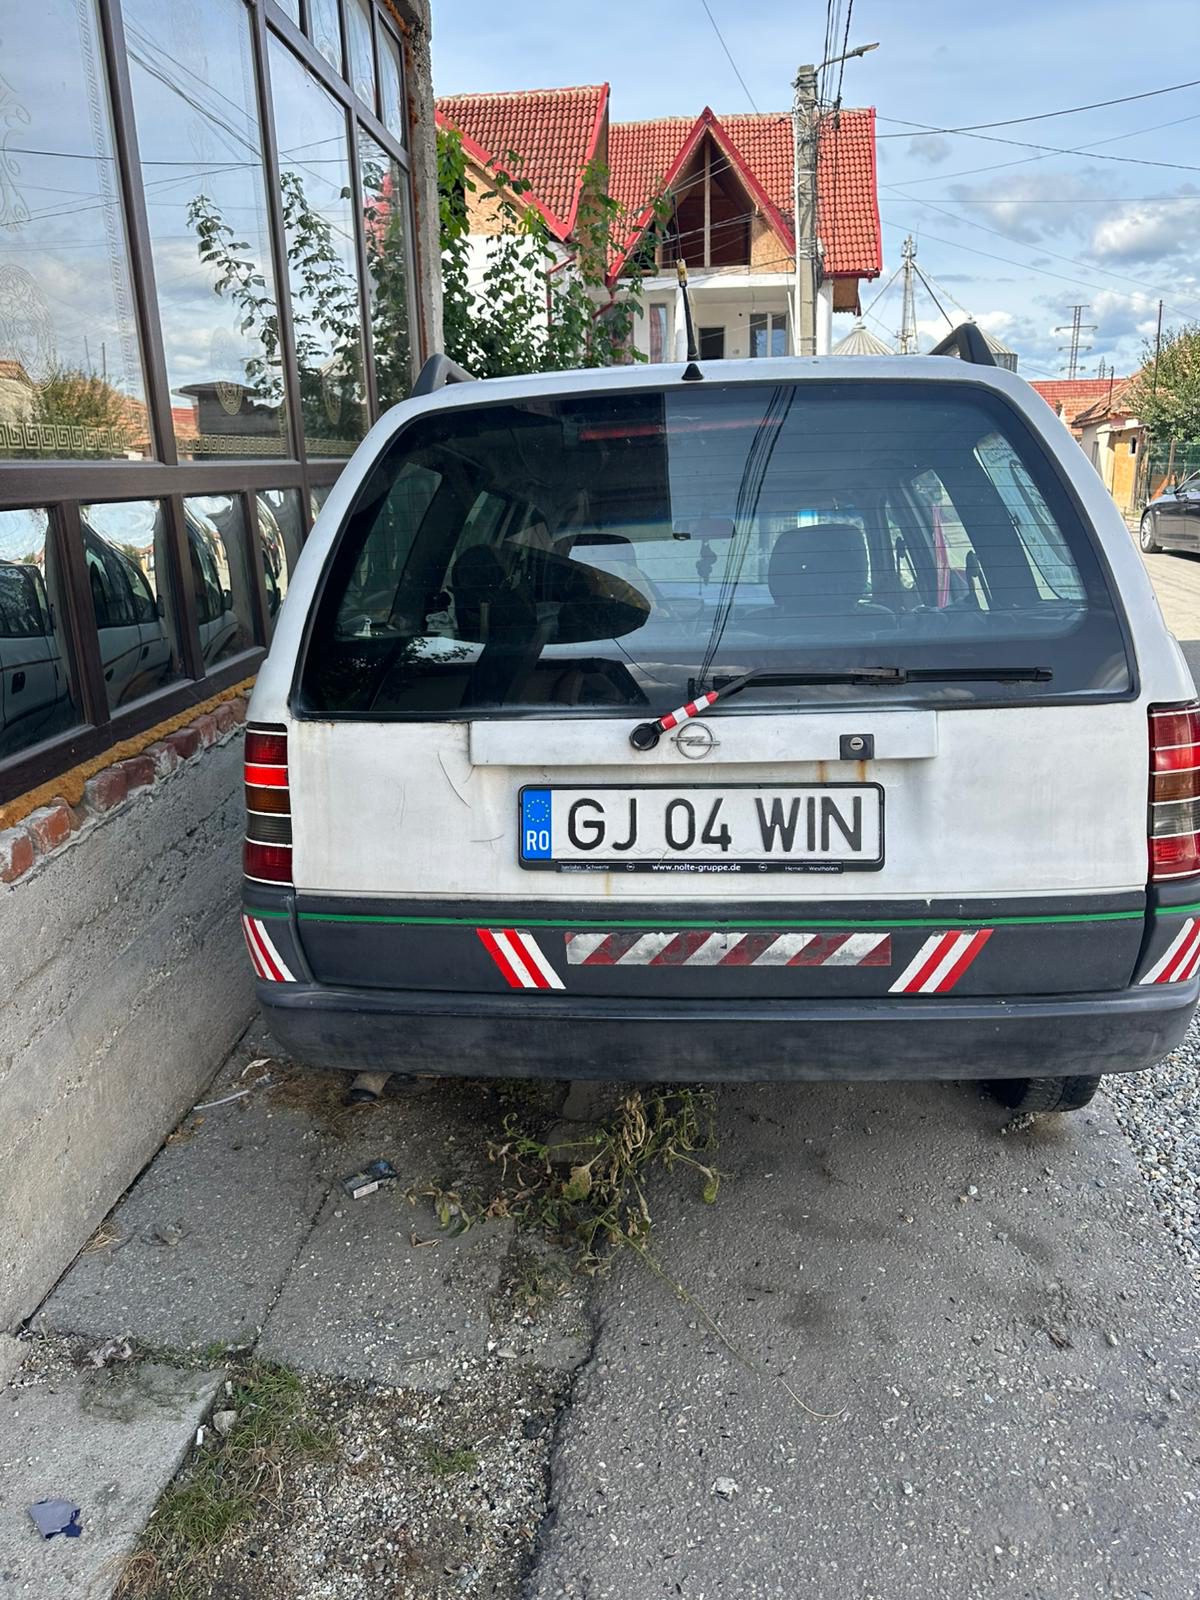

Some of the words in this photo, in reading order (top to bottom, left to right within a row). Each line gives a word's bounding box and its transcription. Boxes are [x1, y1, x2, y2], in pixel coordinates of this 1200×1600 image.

[567, 797, 638, 851] GJ
[665, 797, 732, 852] 04
[754, 796, 862, 852] WIN
[526, 830, 550, 851] RO
[652, 863, 741, 873] www.nolte-gruppe.de
